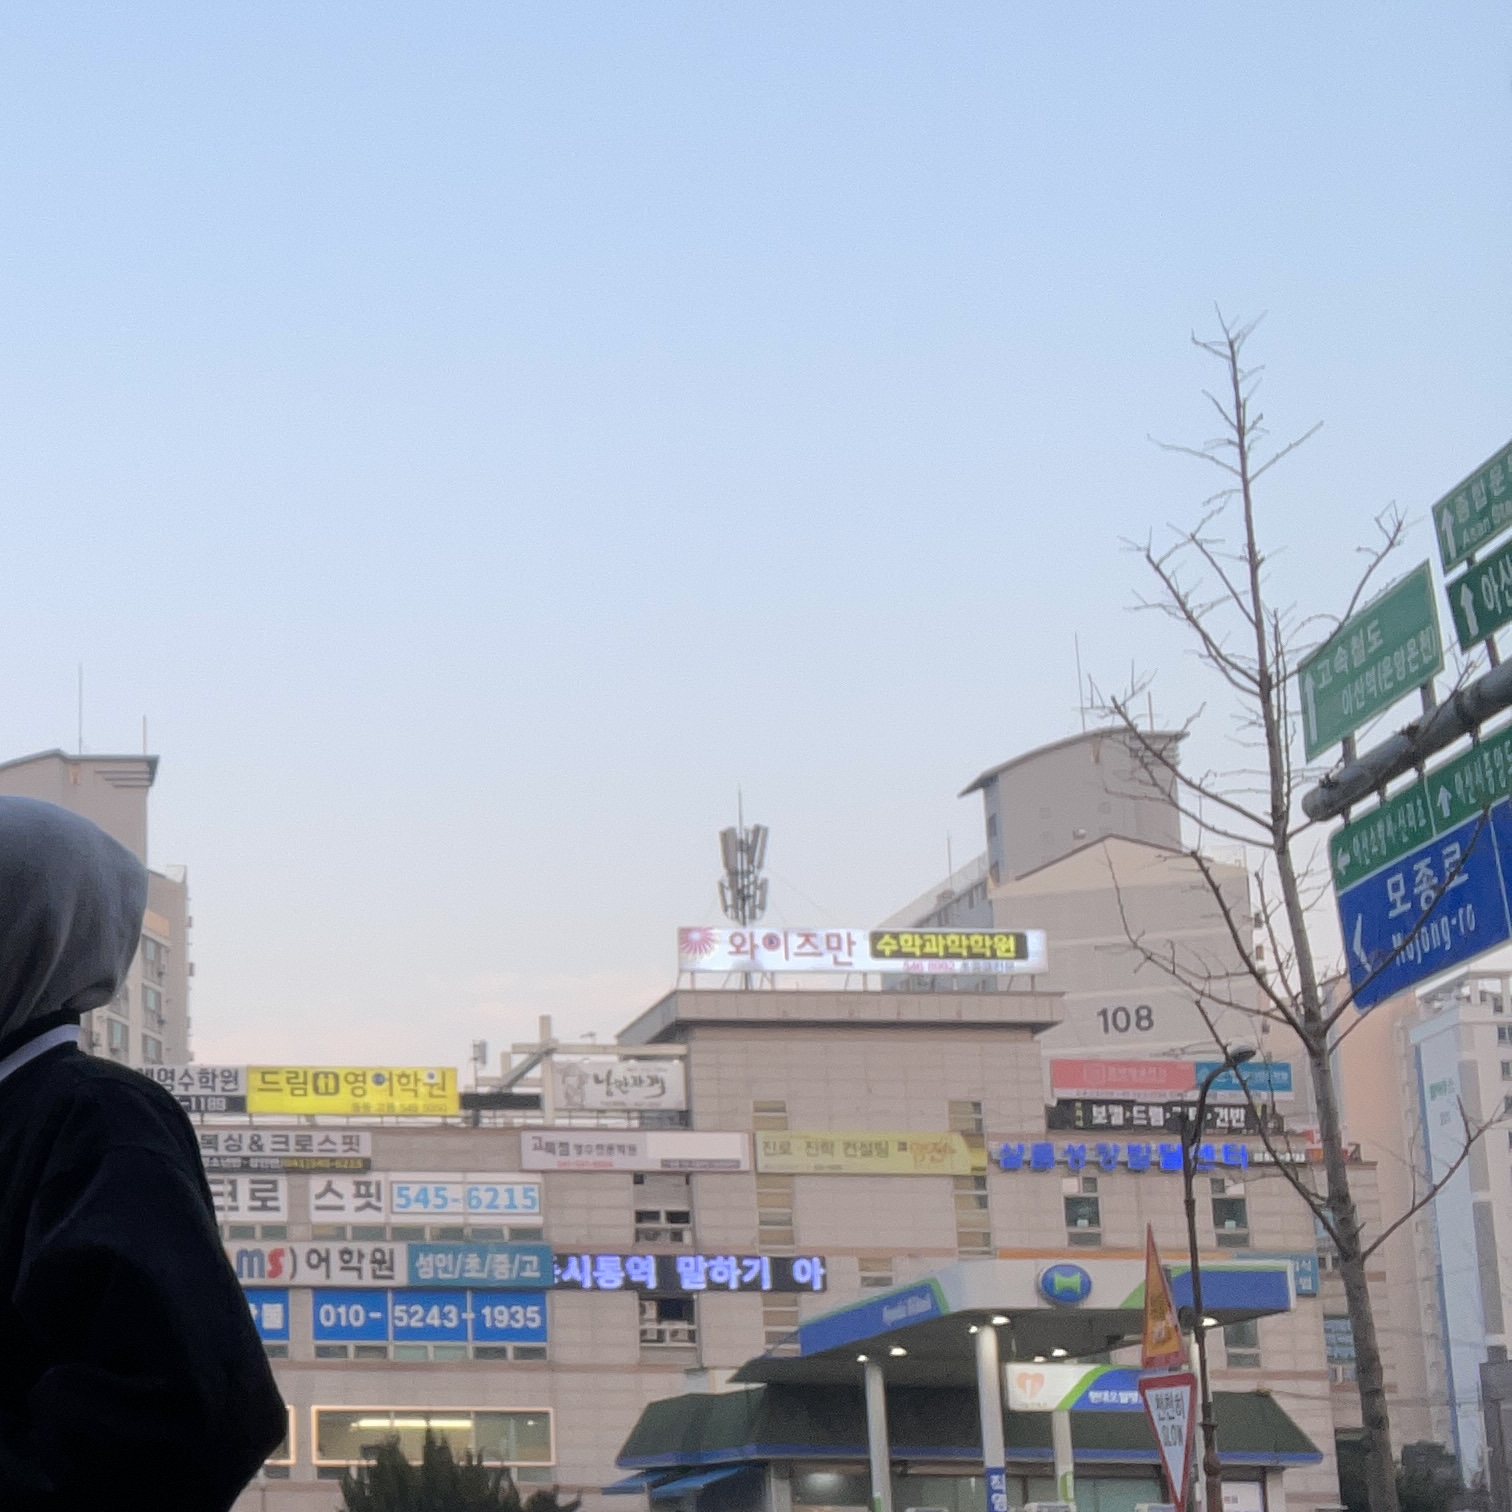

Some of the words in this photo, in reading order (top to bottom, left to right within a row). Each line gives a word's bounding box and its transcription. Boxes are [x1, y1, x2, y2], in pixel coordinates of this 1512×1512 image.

[1386, 841, 1469, 920] 모종로
[727, 931, 858, 968] 와이즈만
[876, 932, 1018, 959] 수학과학학원
[1096, 1005, 1155, 1035] 108
[394, 1185, 538, 1211] 545-6215
[553, 1254, 657, 1290] 시통역
[676, 1255, 772, 1290] 말하기
